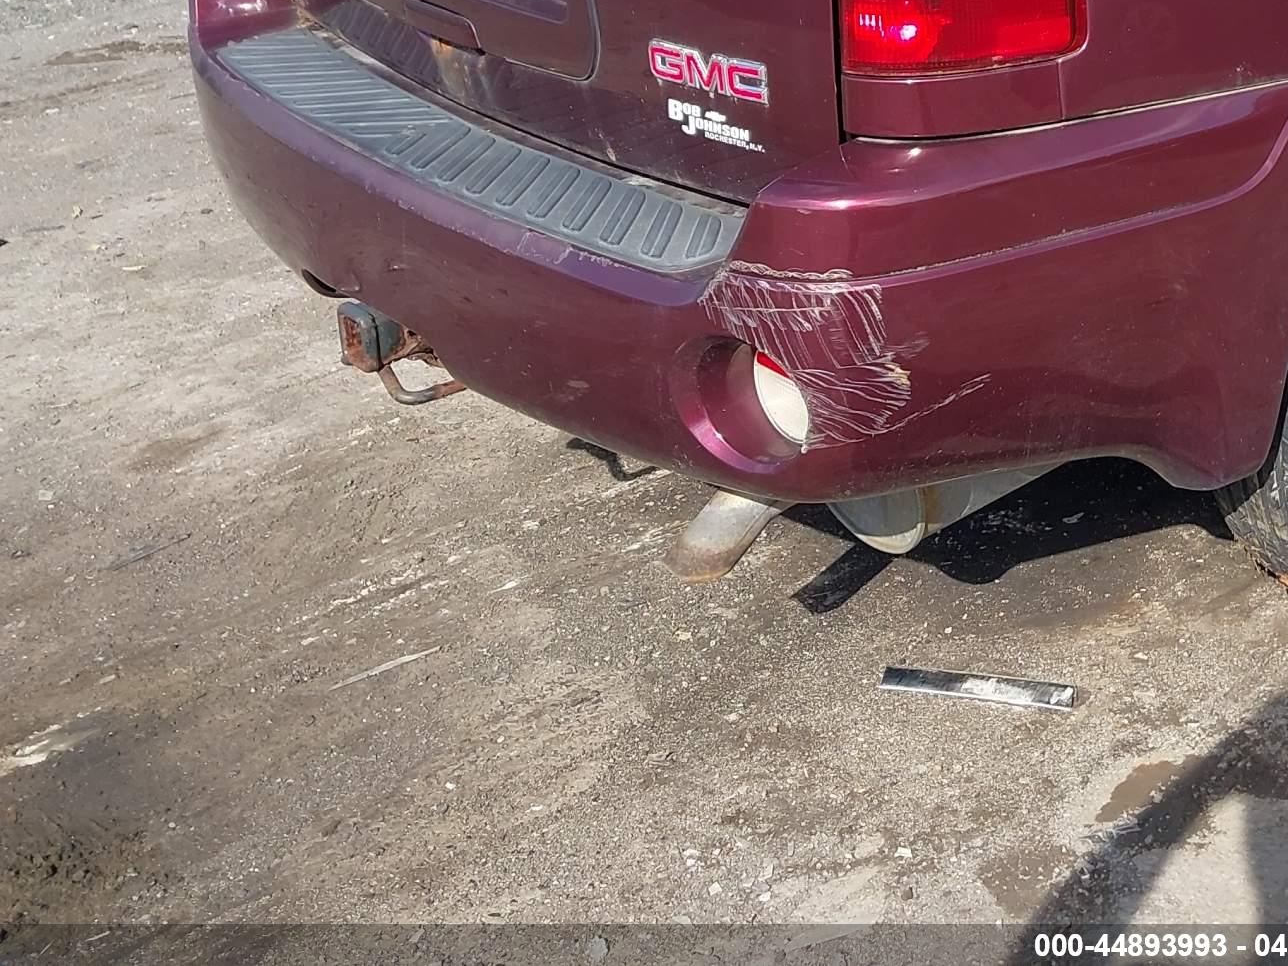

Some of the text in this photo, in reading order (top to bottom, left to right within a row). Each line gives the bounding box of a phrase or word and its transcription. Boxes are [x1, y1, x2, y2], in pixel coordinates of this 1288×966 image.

[648, 37, 769, 107] GMC
[667, 98, 701, 121] BOB
[681, 115, 750, 142] JOHNSON
